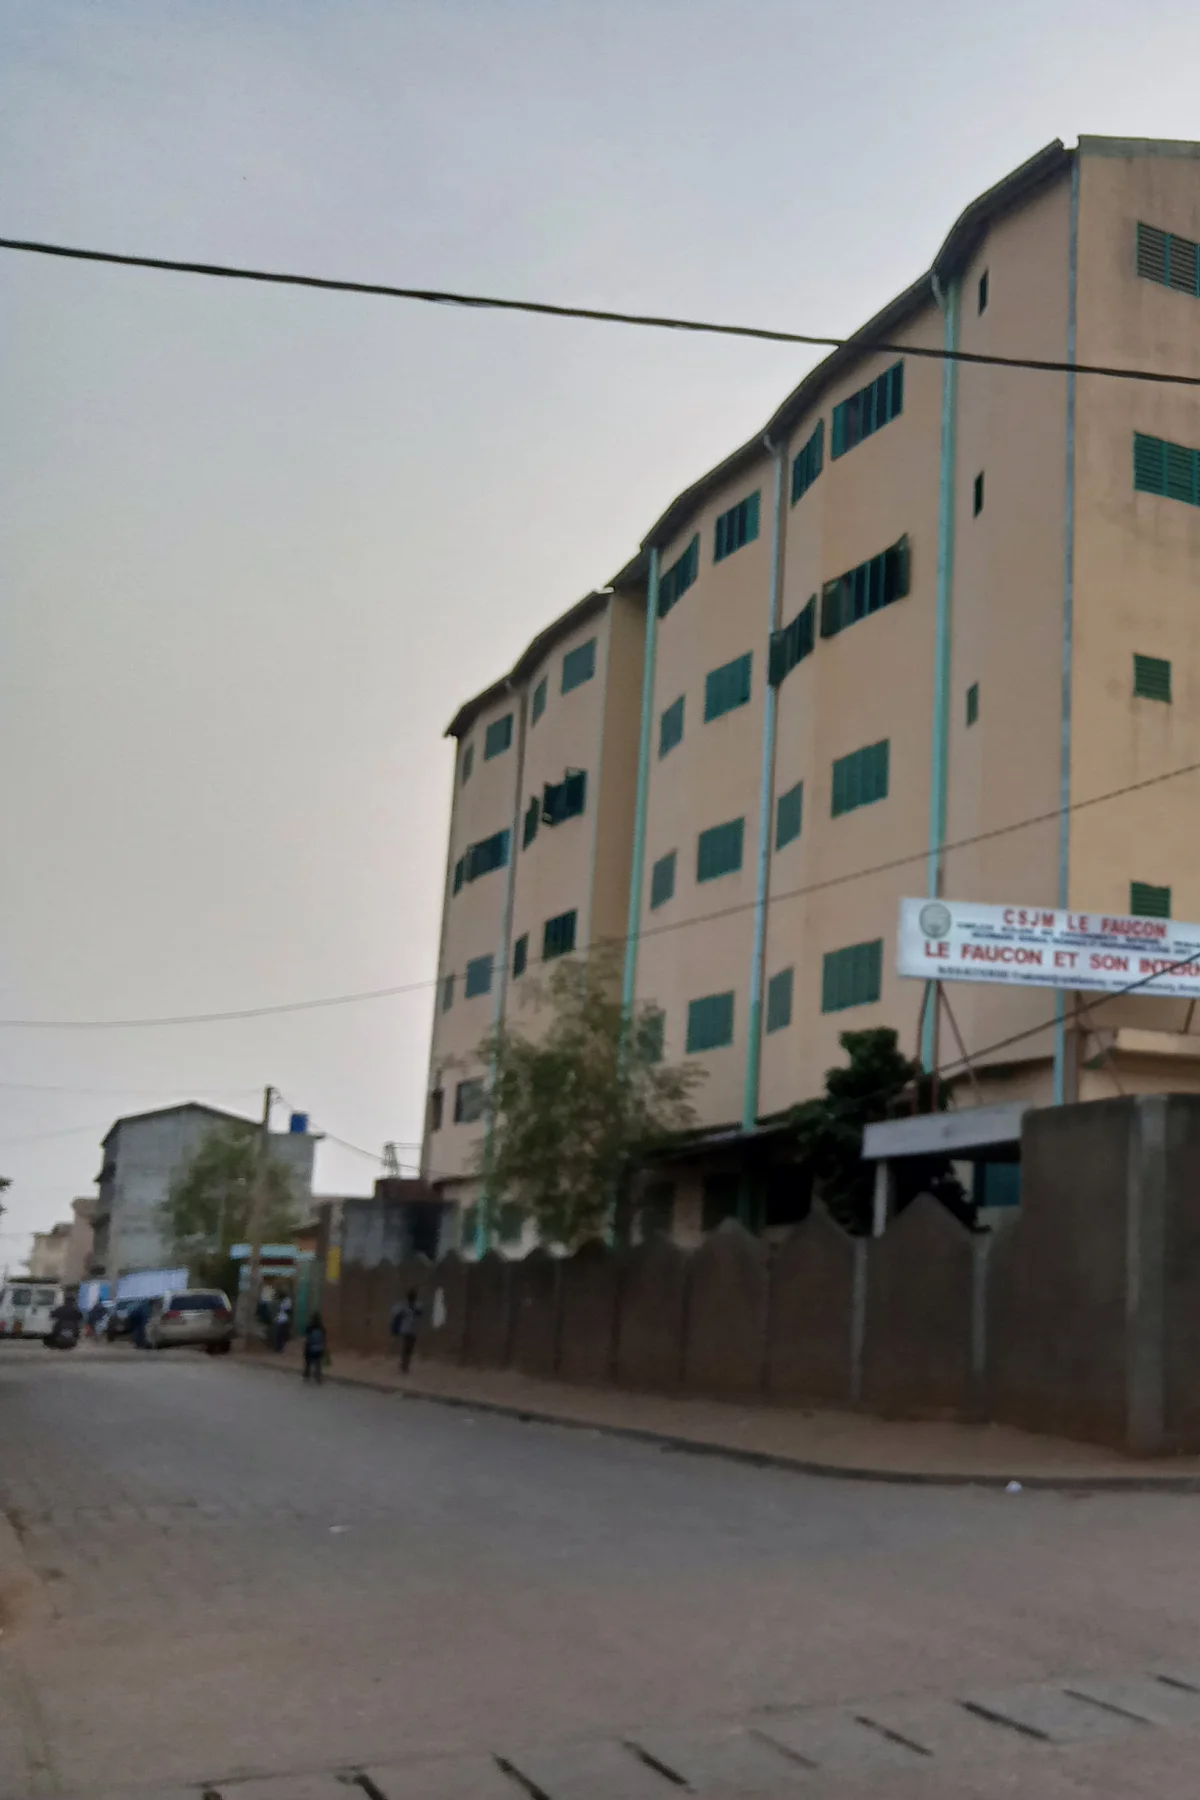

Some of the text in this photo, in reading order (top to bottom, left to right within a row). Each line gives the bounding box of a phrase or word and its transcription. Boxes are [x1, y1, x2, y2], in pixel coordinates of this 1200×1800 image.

[1003, 908, 1055, 927] CSJM
[1067, 914, 1089, 932] LE
[1101, 917, 1168, 937] FAUCON
[925, 941, 949, 958] LE
[960, 943, 1044, 965] FAUCON
[1054, 951, 1079, 968] ET
[1089, 953, 1129, 971] SON
